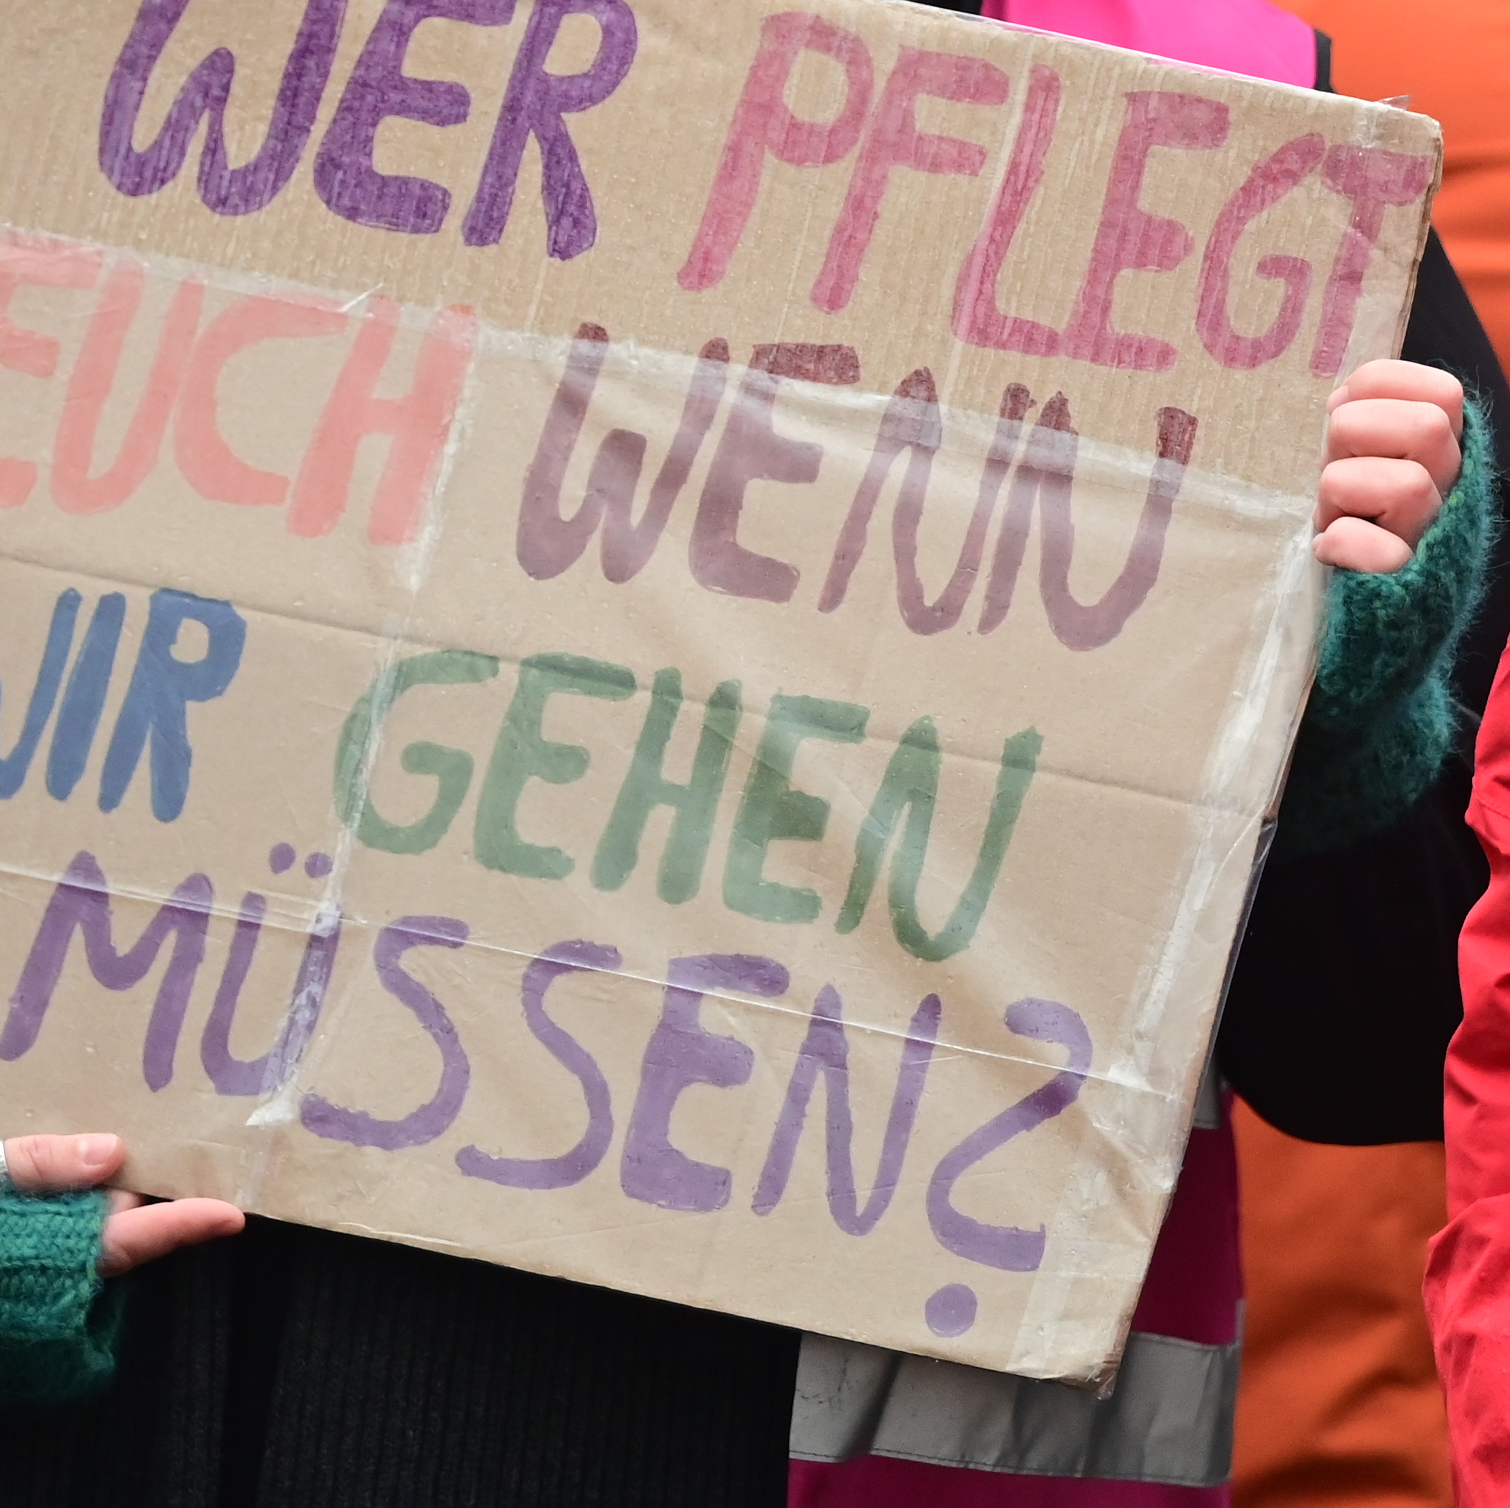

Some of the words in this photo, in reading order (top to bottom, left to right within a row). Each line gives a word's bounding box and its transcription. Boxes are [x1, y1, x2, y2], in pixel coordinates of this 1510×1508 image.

[678, 12, 1436, 377] PFLEGT
[515, 322, 1197, 652] WENN
[334, 648, 1043, 962] GEHEN
